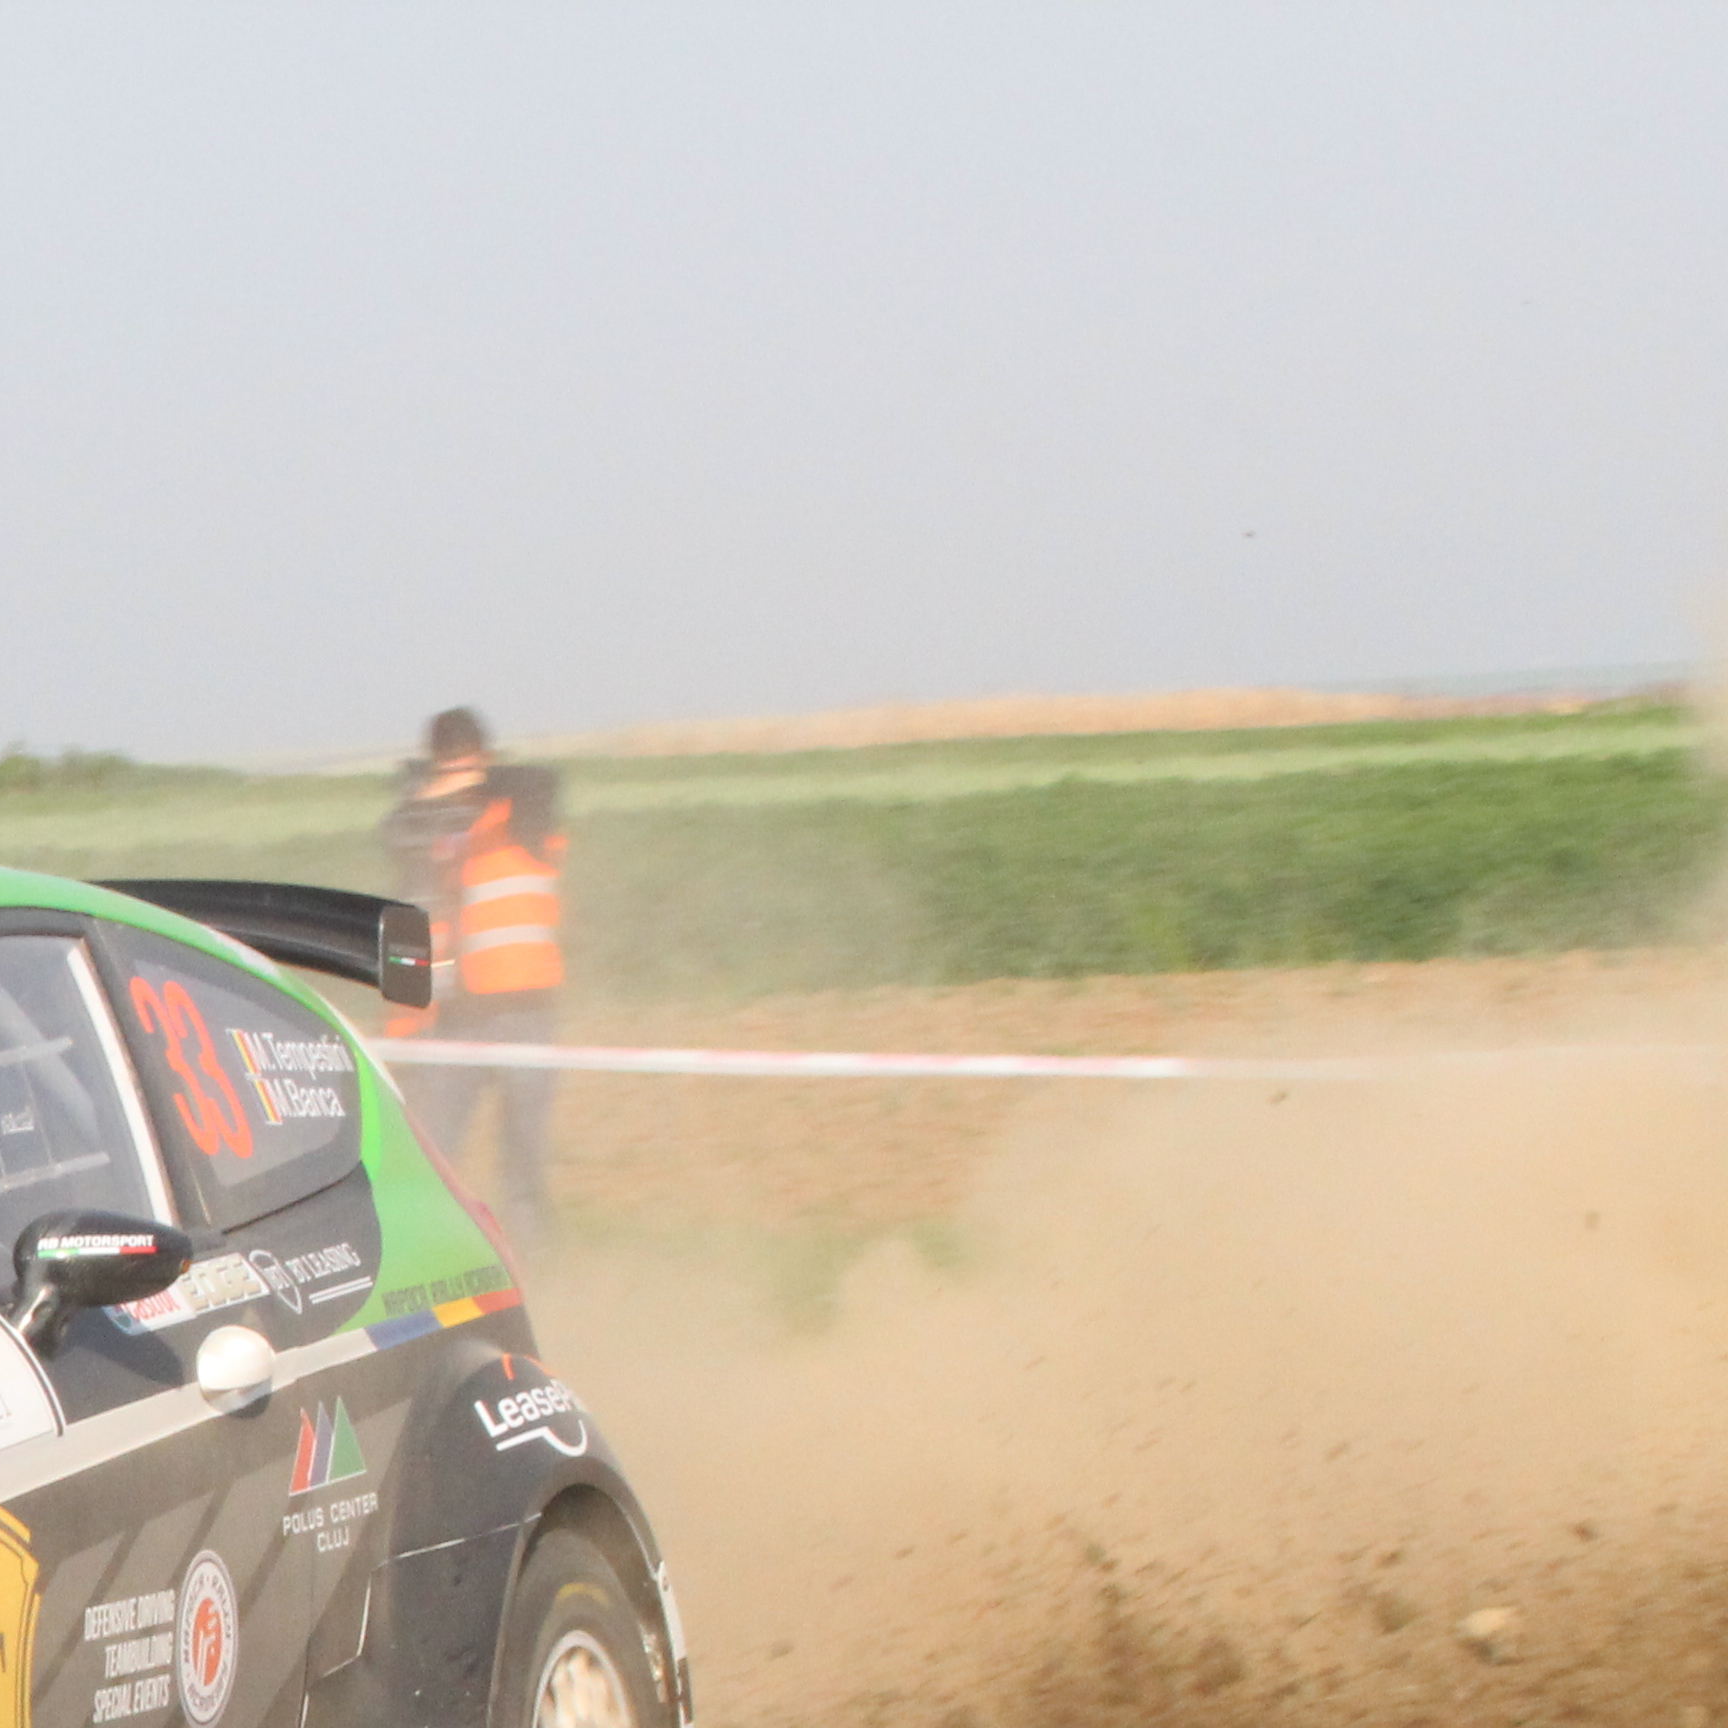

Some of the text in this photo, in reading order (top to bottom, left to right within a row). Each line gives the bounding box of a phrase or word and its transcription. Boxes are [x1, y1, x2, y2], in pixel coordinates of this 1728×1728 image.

[129, 976, 254, 1159] 33
[61, 1234, 155, 1248] MOTORSPORT
[282, 1492, 378, 1536] POLUS CENTER
[316, 1526, 350, 1552] CLUJ
